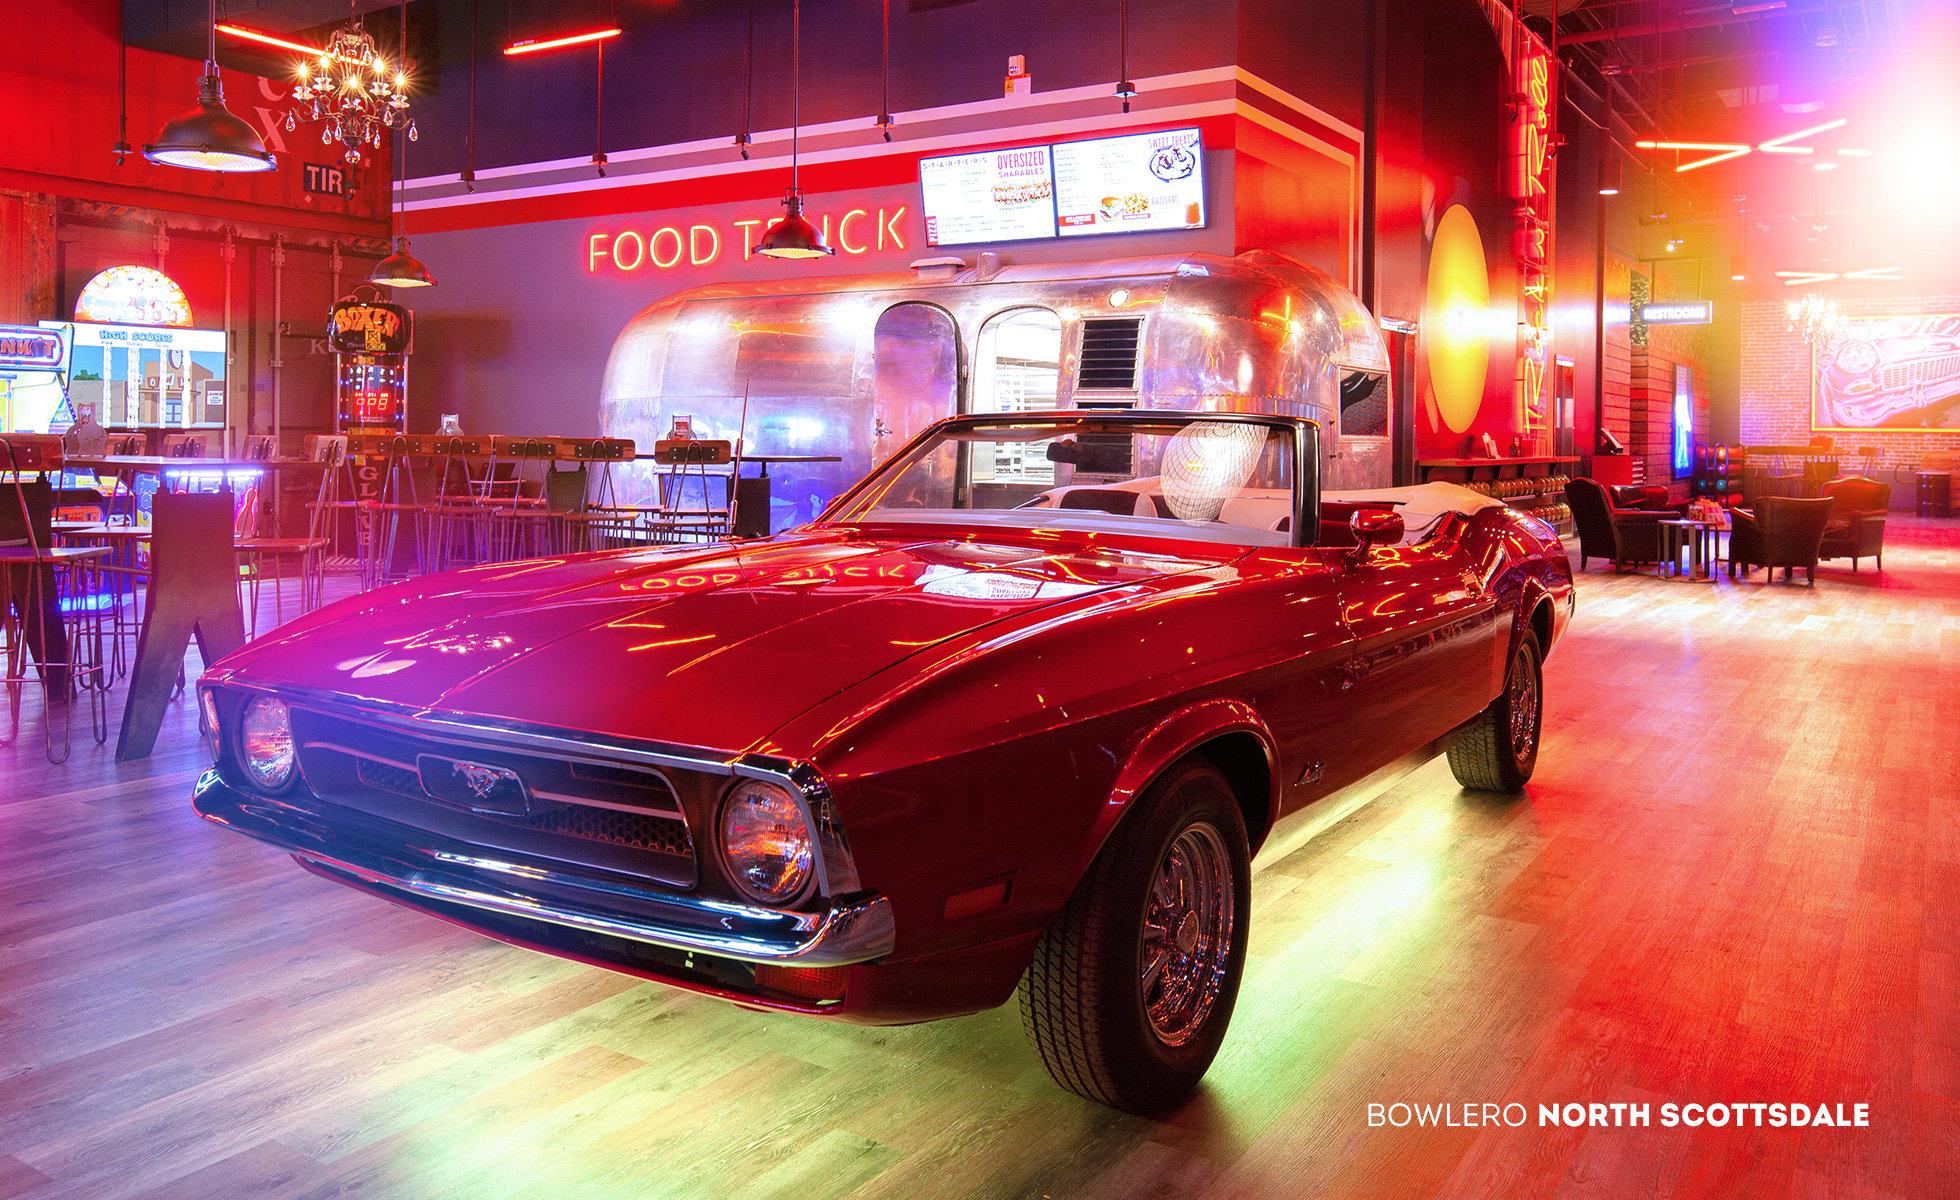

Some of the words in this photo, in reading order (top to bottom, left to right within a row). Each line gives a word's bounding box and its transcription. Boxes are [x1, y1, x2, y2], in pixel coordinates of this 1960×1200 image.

[1527, 55, 1548, 197] Roll
[997, 150, 1045, 170] OVERSIZED
[998, 167, 1045, 179] SHARABLES
[306, 165, 343, 194] TIR
[589, 224, 719, 272] FOOD
[733, 206, 907, 261] TCK
[928, 216, 938, 244] PIZZA
[333, 306, 400, 337] BOXER
